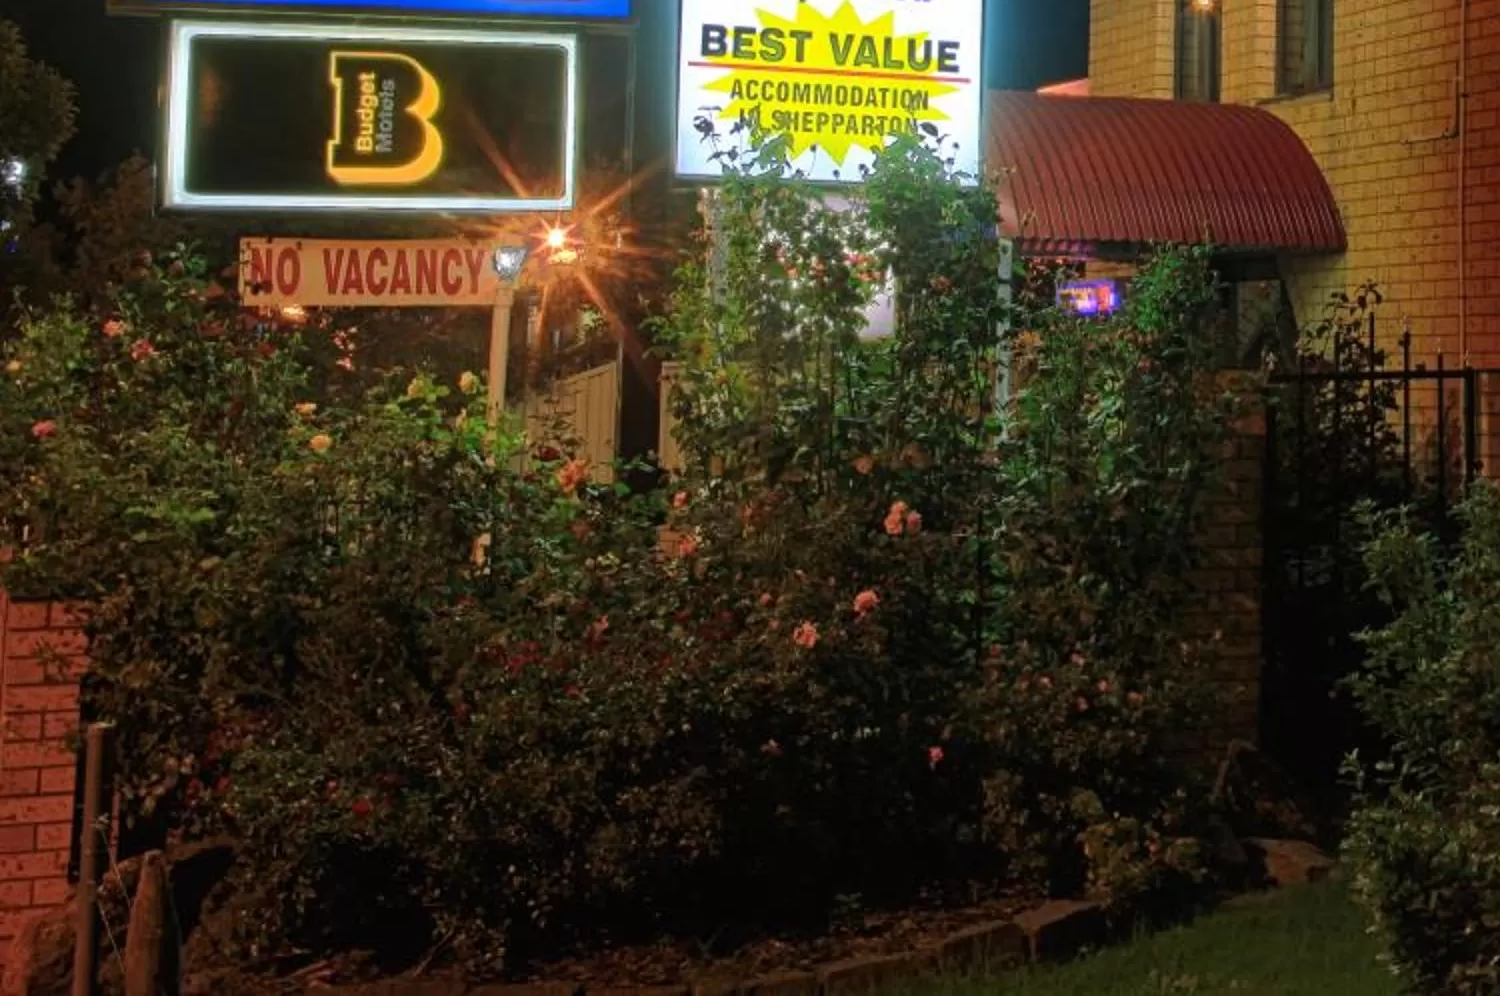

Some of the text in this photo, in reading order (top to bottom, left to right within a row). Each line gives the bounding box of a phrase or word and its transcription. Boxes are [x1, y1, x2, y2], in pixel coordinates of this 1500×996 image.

[700, 23, 961, 74] BEST VALUE
[327, 51, 443, 185] B
[355, 69, 380, 154] Budget
[729, 79, 930, 111] ACCOMMODATION
[250, 246, 487, 297] NO VACANCY
